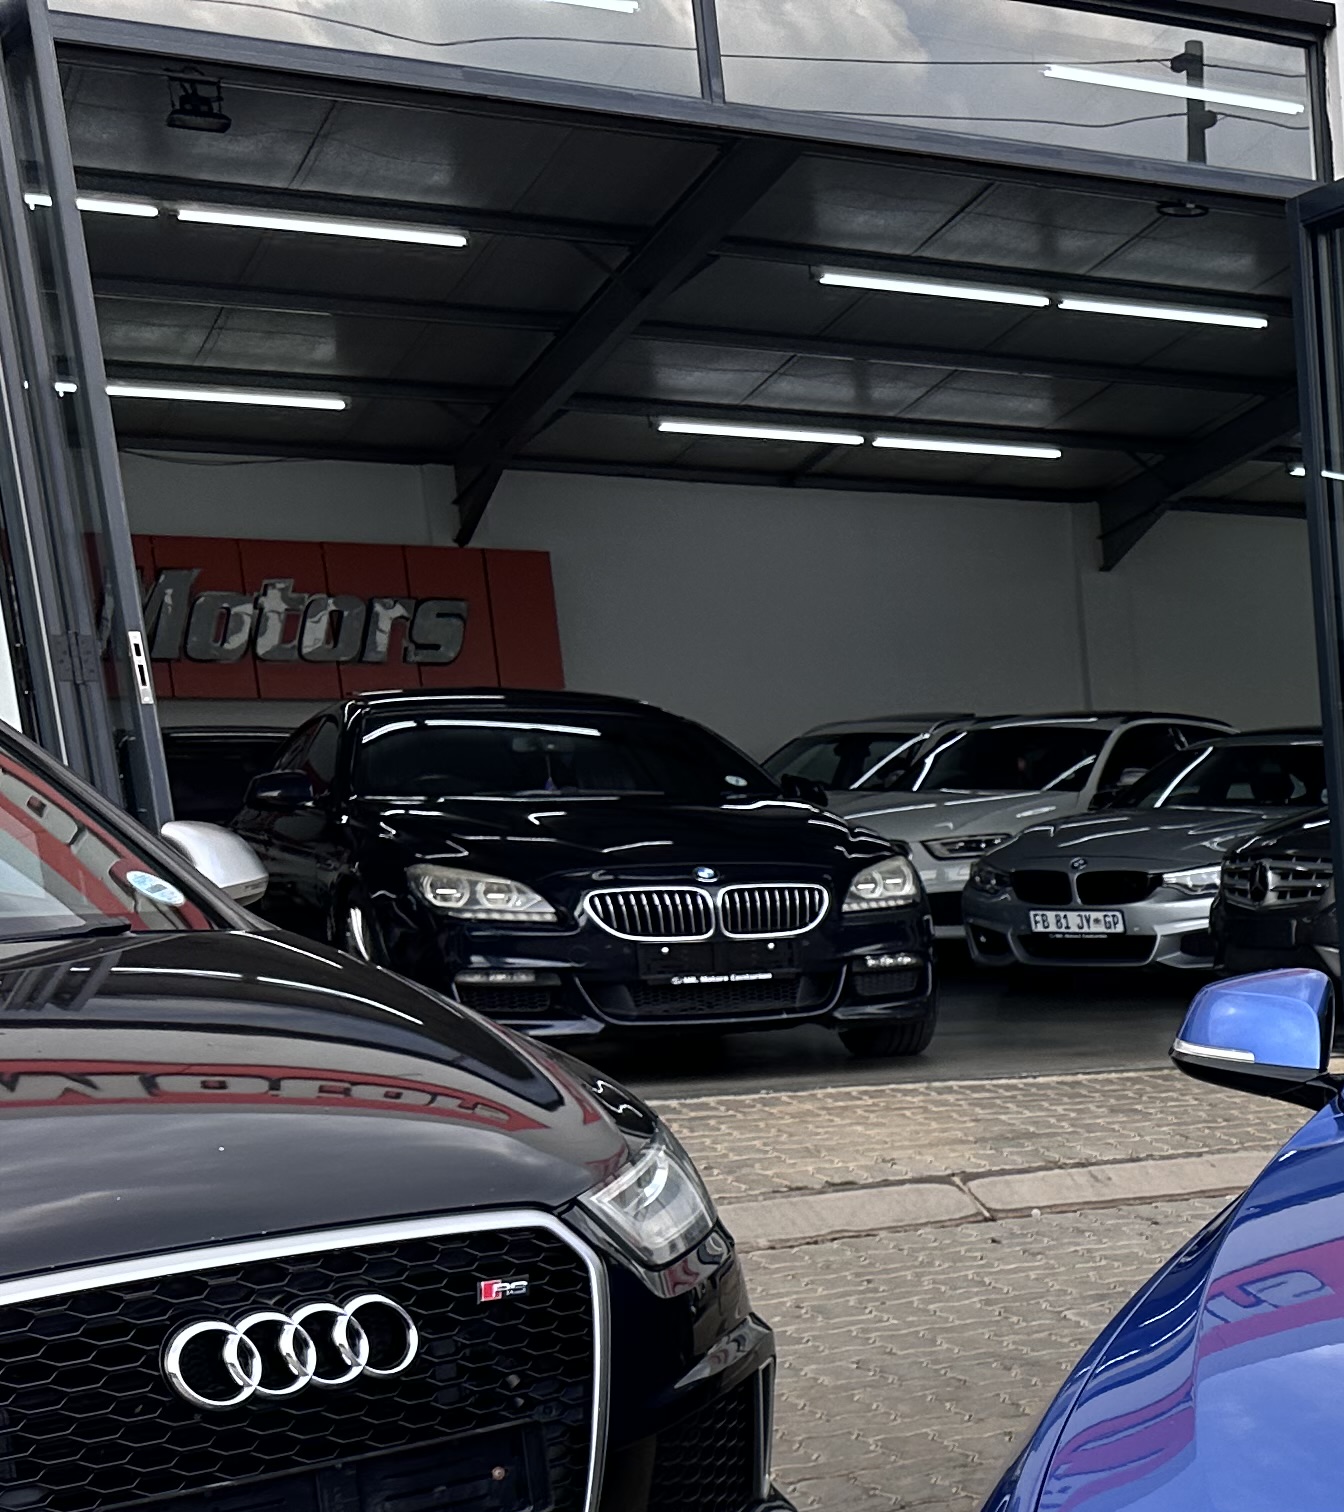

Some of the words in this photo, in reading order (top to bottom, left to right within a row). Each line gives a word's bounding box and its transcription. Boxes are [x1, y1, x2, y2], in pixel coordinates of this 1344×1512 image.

[1033, 913, 1049, 930] FB
[1055, 913, 1071, 930] 81
[1077, 913, 1091, 930] JY
[1103, 913, 1119, 931] GP
